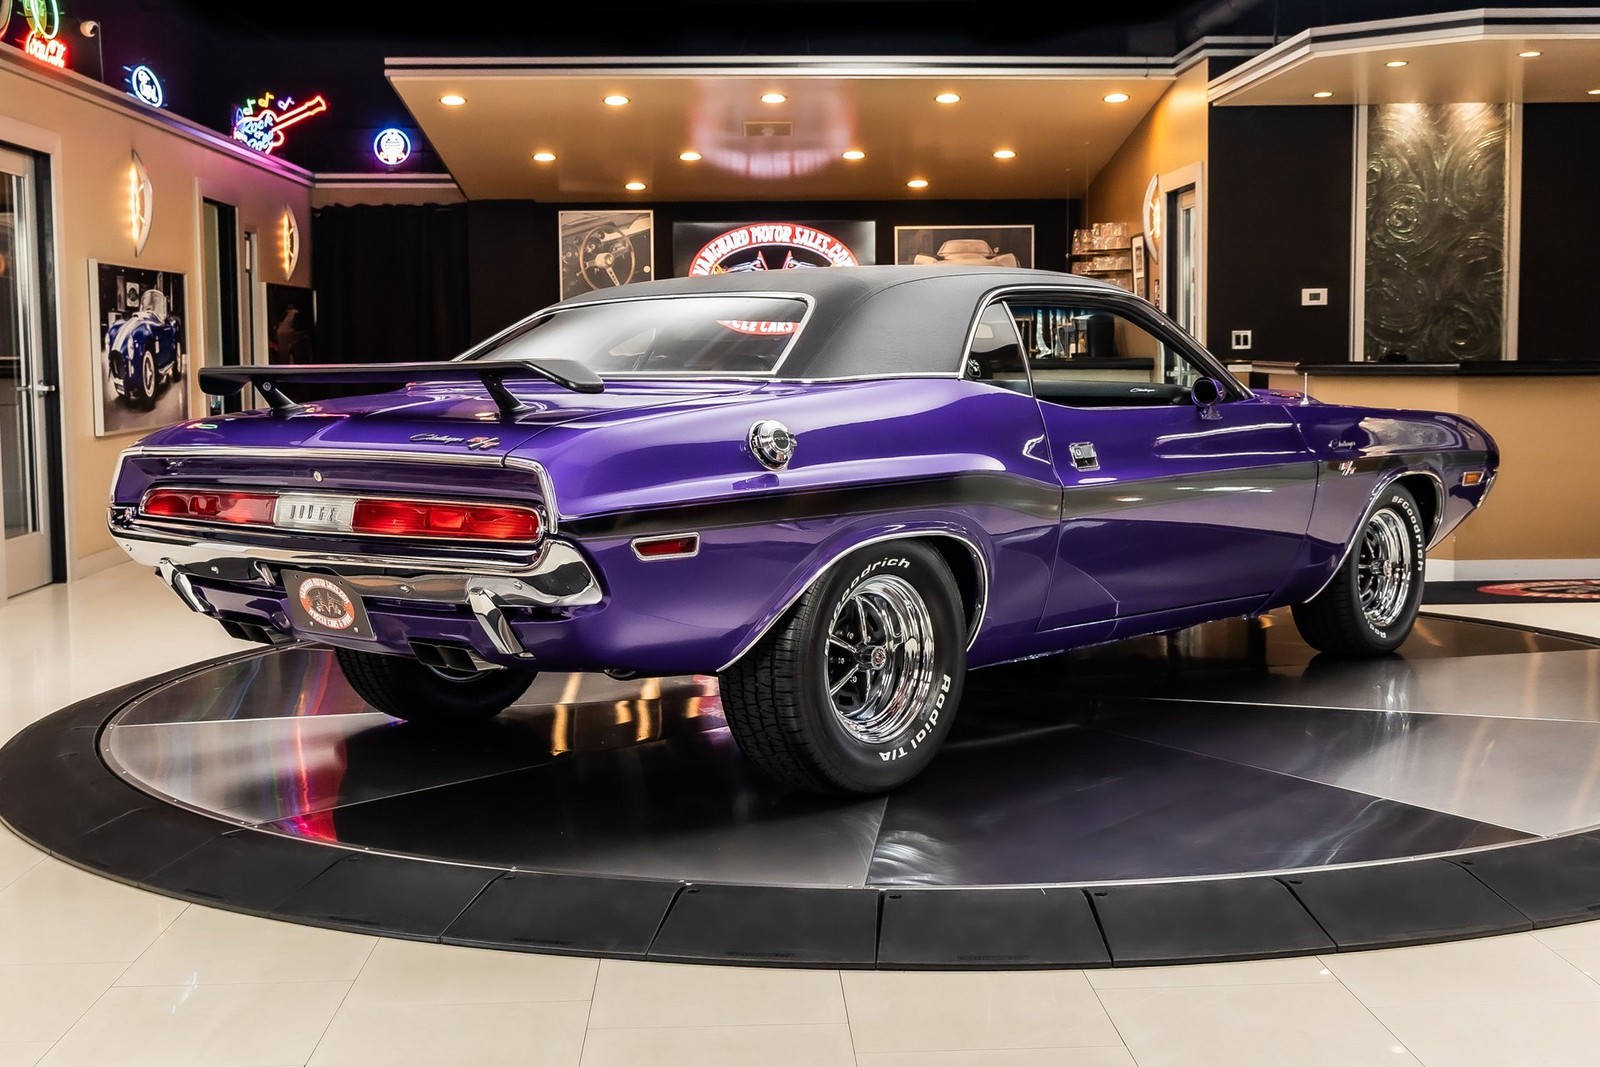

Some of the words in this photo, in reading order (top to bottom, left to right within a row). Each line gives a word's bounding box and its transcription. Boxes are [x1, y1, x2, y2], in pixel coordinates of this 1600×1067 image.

[693, 229, 750, 275] VANGUARD
[750, 225, 792, 243] MOTOR
[289, 505, 336, 521] DODGE
[1392, 496, 1423, 571] BFGoodrich
[911, 674, 951, 749] Radial
[879, 747, 908, 761] T/A
